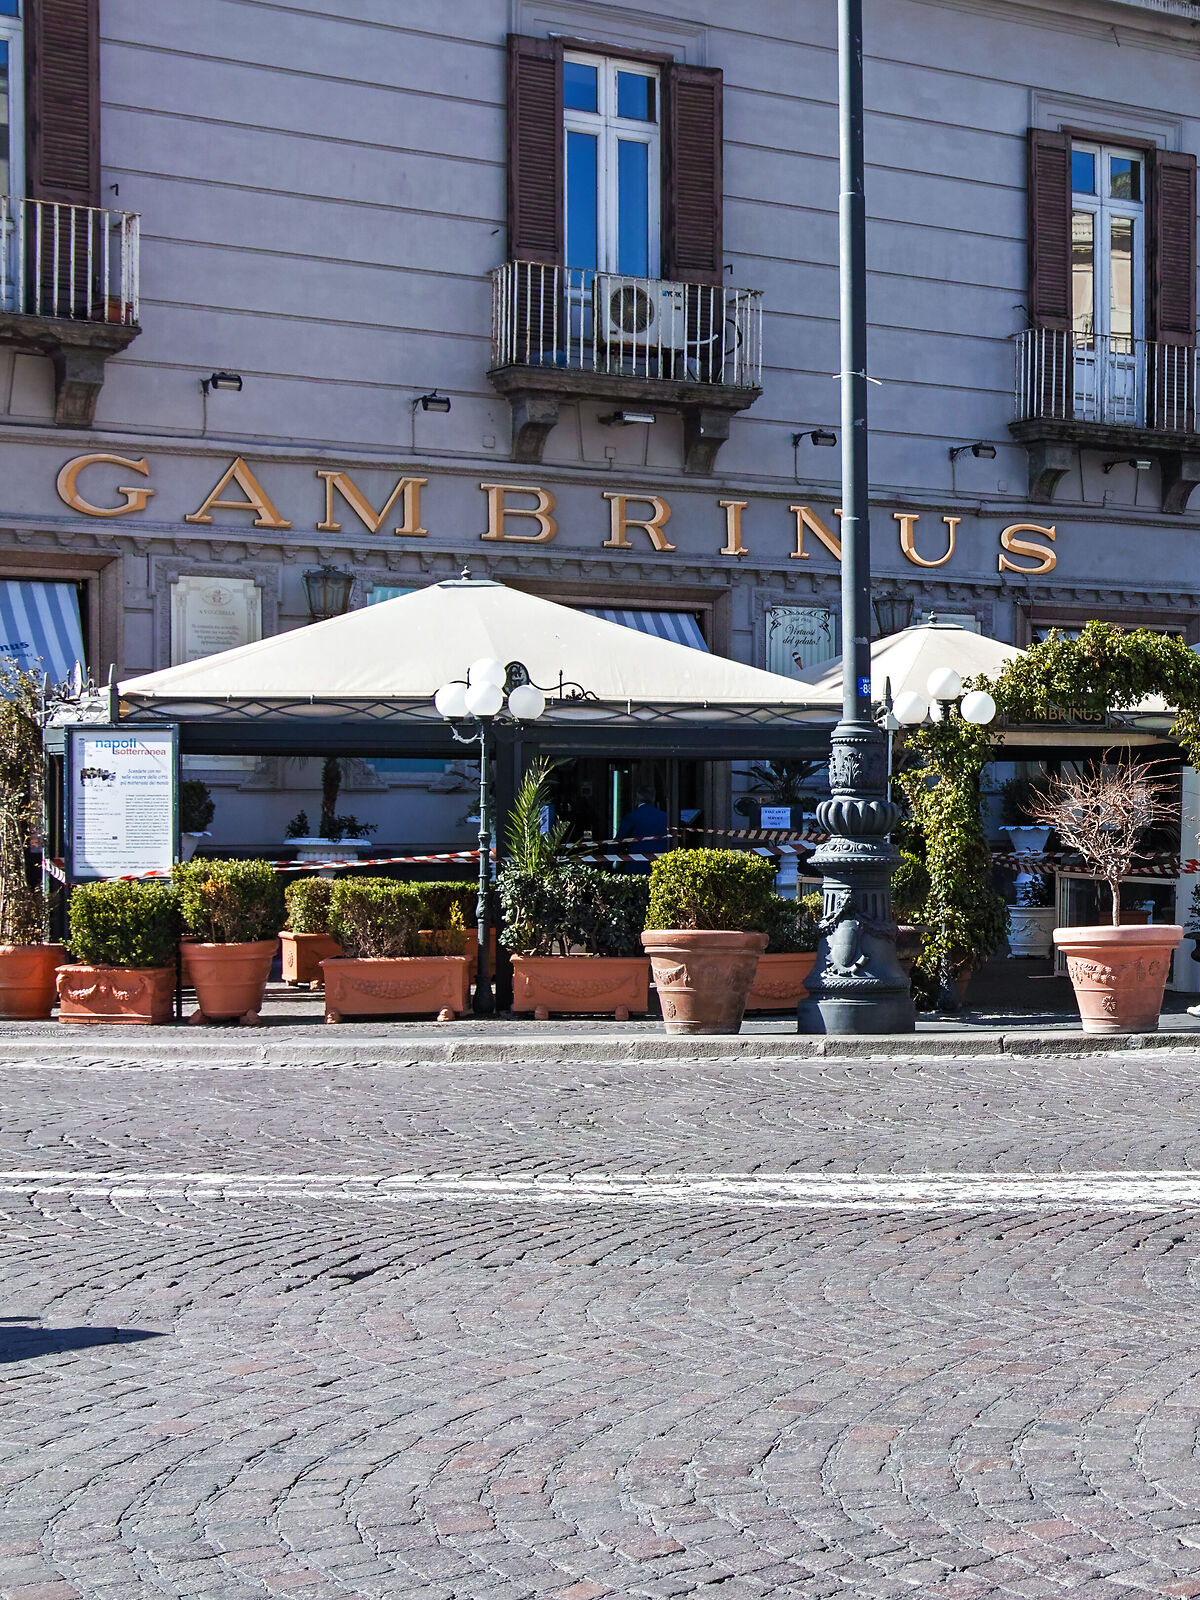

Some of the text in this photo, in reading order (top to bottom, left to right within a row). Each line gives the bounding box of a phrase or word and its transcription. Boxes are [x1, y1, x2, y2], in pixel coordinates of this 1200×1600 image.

[56, 452, 1057, 575] GAMBRINUS
[785, 623, 816, 636] Virtuosi
[782, 635, 821, 649] del gelato!
[95, 738, 137, 754] napoli
